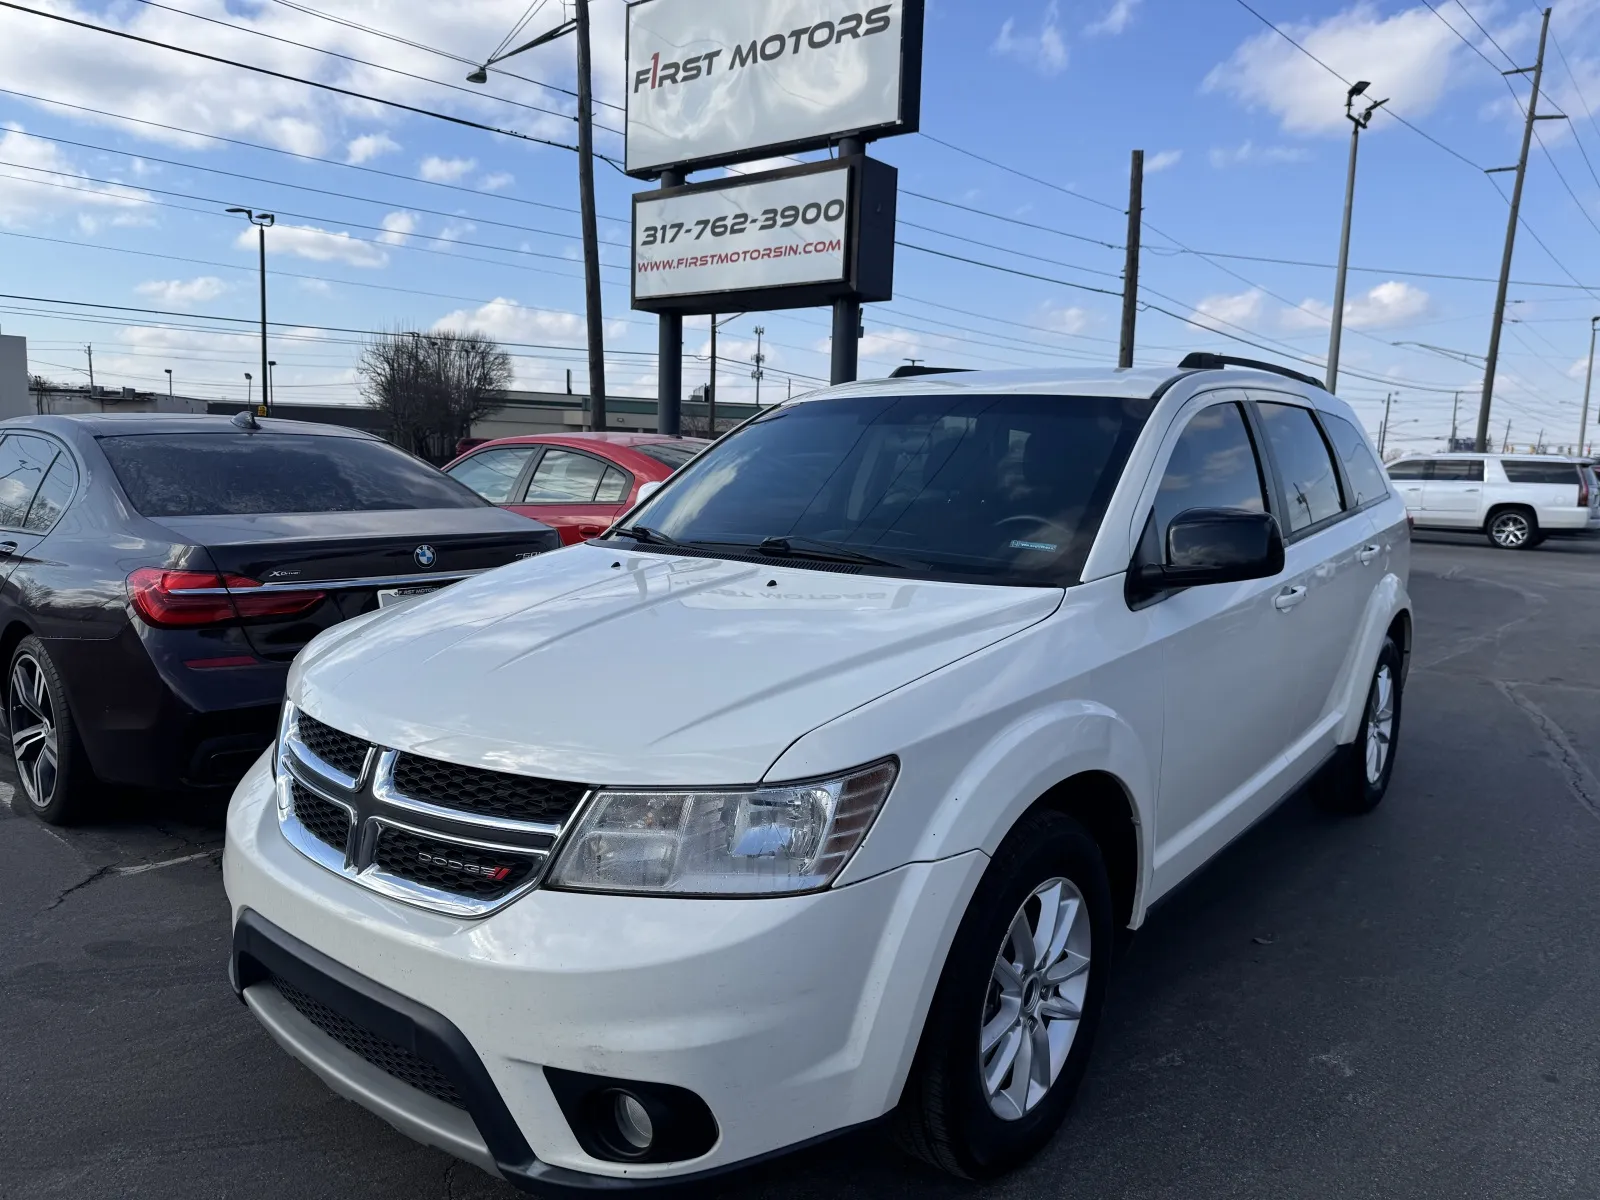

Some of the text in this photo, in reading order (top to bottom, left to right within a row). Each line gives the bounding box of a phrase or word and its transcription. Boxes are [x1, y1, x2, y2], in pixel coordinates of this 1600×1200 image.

[729, 3, 893, 71] MOTORS
[641, 199, 845, 246] 317-762-3900
[637, 239, 841, 273] WWW.FIRSTMOTORSIN.COM
[418, 852, 496, 877] DODGE
